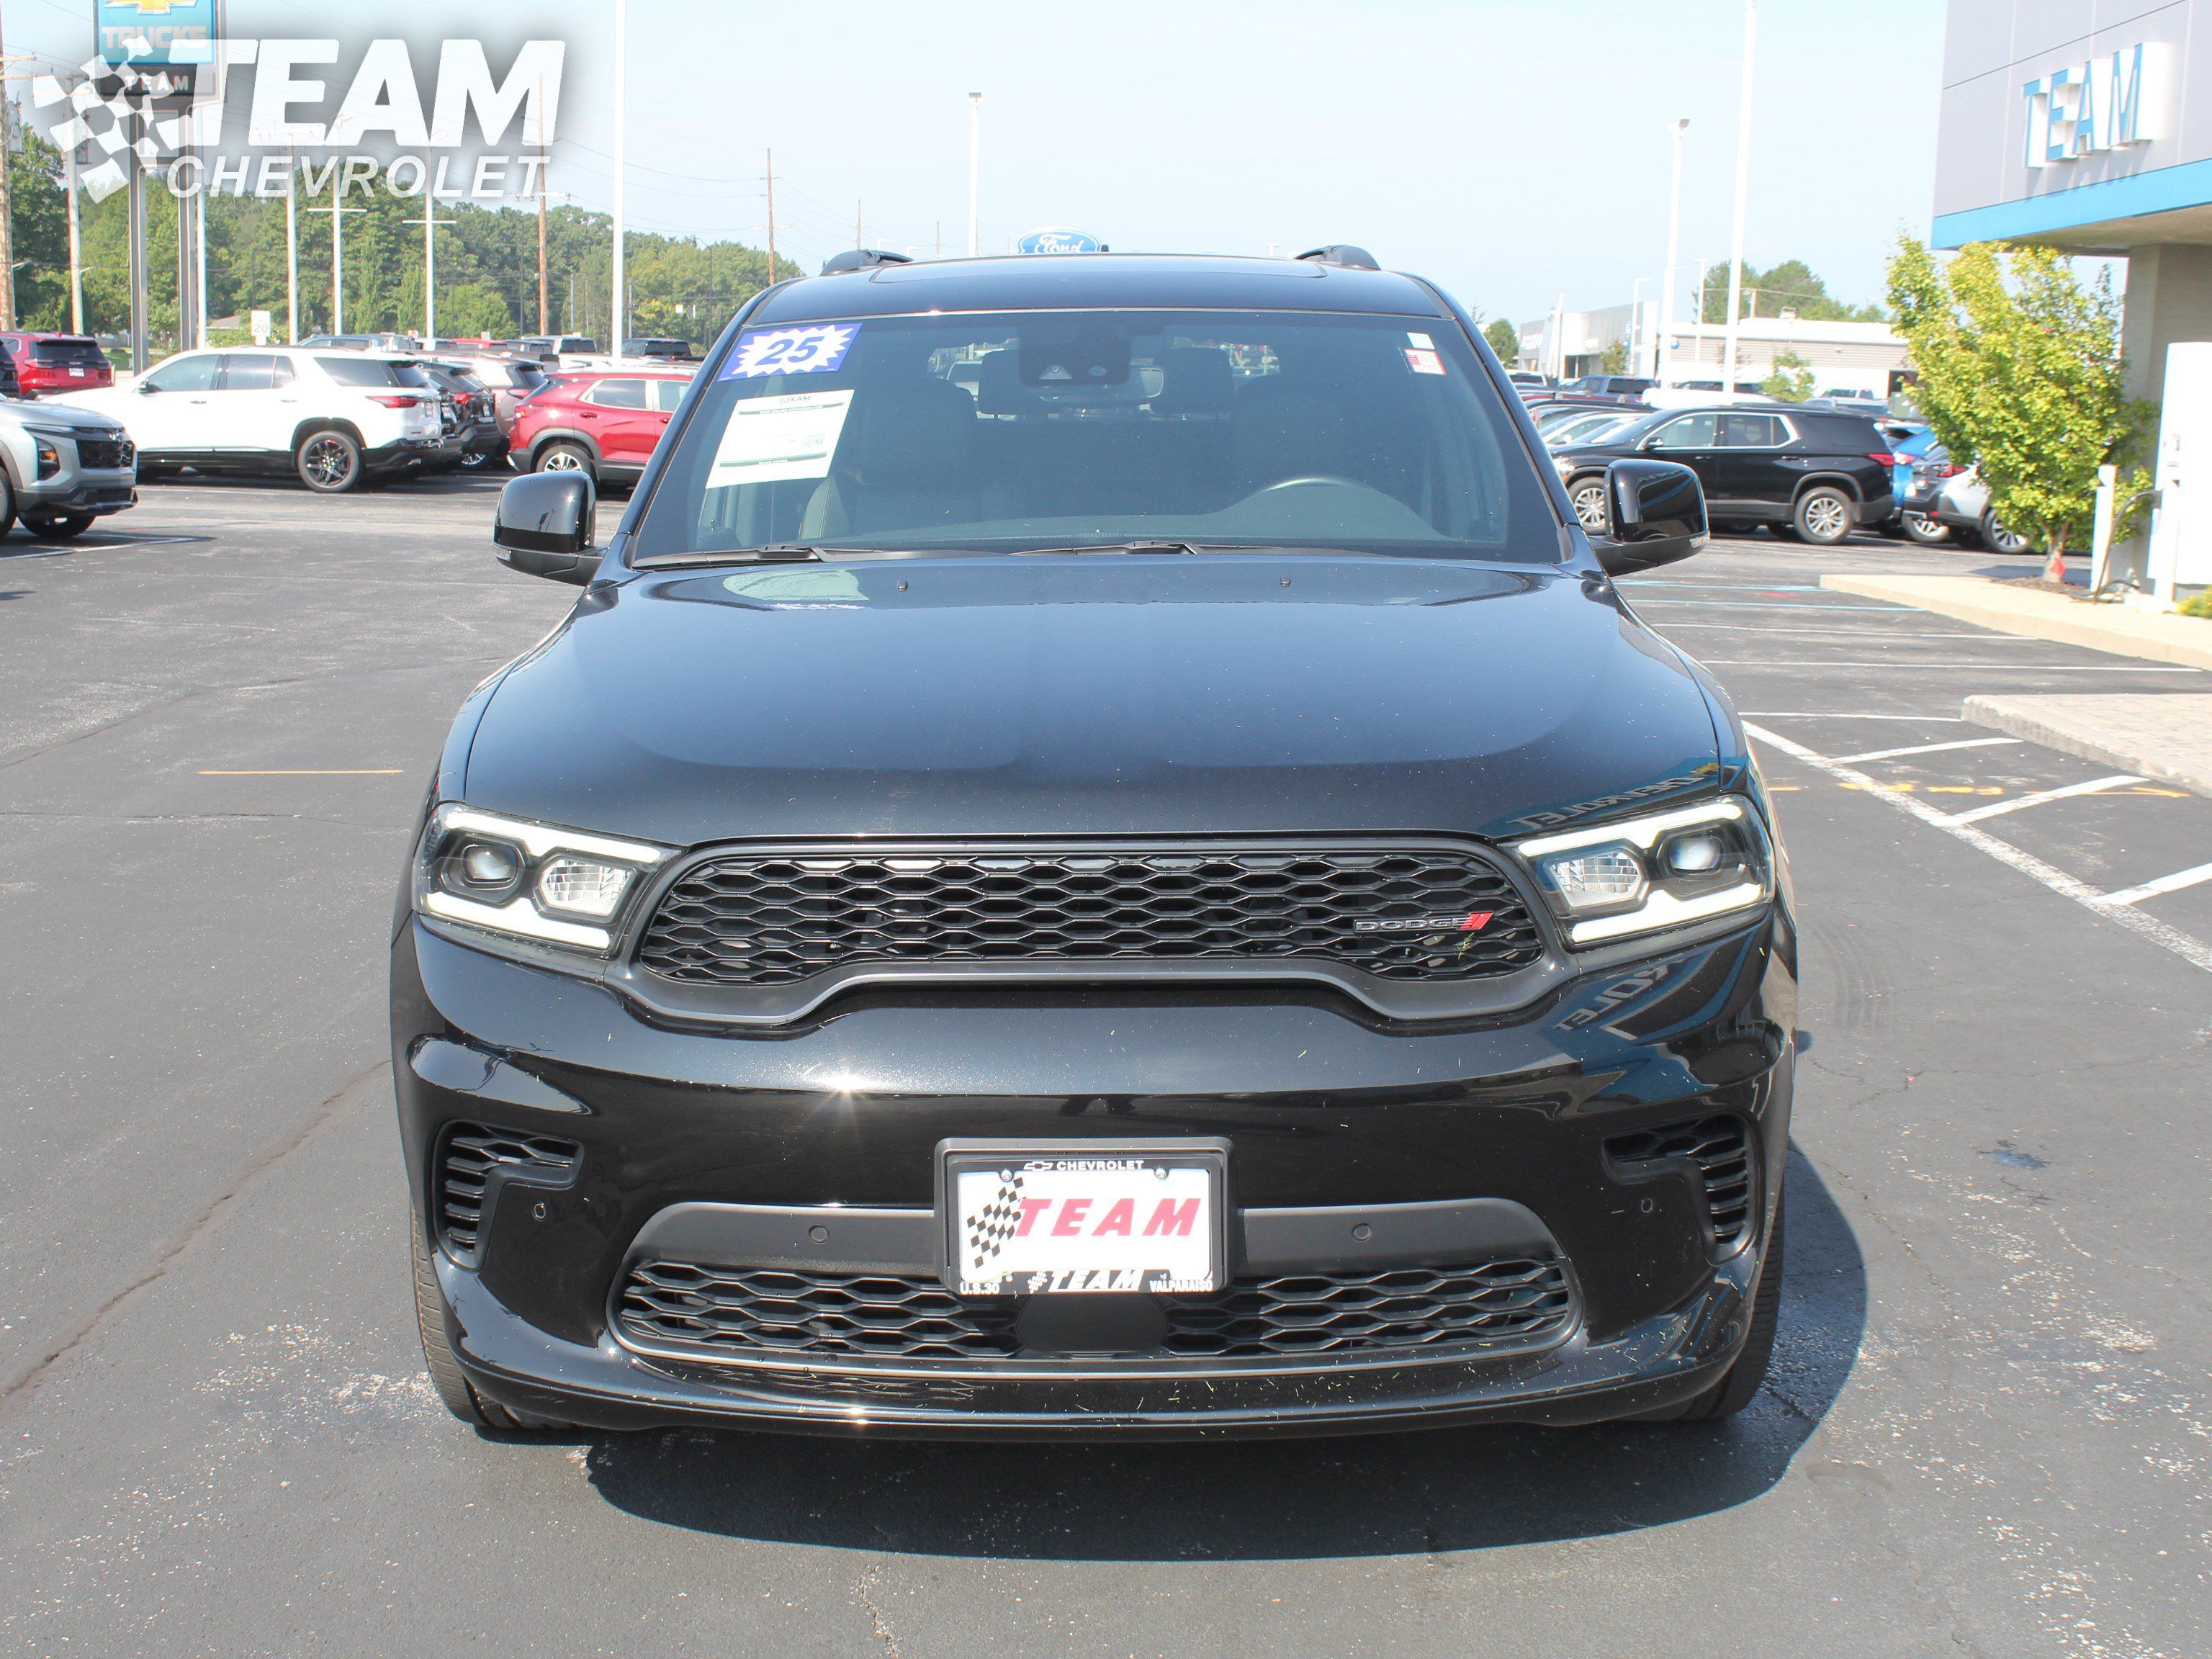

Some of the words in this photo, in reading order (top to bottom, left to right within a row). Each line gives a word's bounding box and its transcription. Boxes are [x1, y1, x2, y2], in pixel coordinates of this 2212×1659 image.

[102, 26, 207, 49] TRUCKS
[124, 76, 189, 91] TEAM
[2020, 42, 2162, 168] TEAM
[1034, 234, 1084, 253] Ford
[254, 324, 268, 333] 20
[755, 336, 825, 366] 25
[1356, 917, 1473, 930] DODGE
[1056, 1160, 1144, 1172] CHEVROLET
[1015, 1198, 1201, 1236] TEAM
[1048, 1269, 1144, 1292] TEAM
[1150, 1278, 1213, 1292] VALPARAISO
